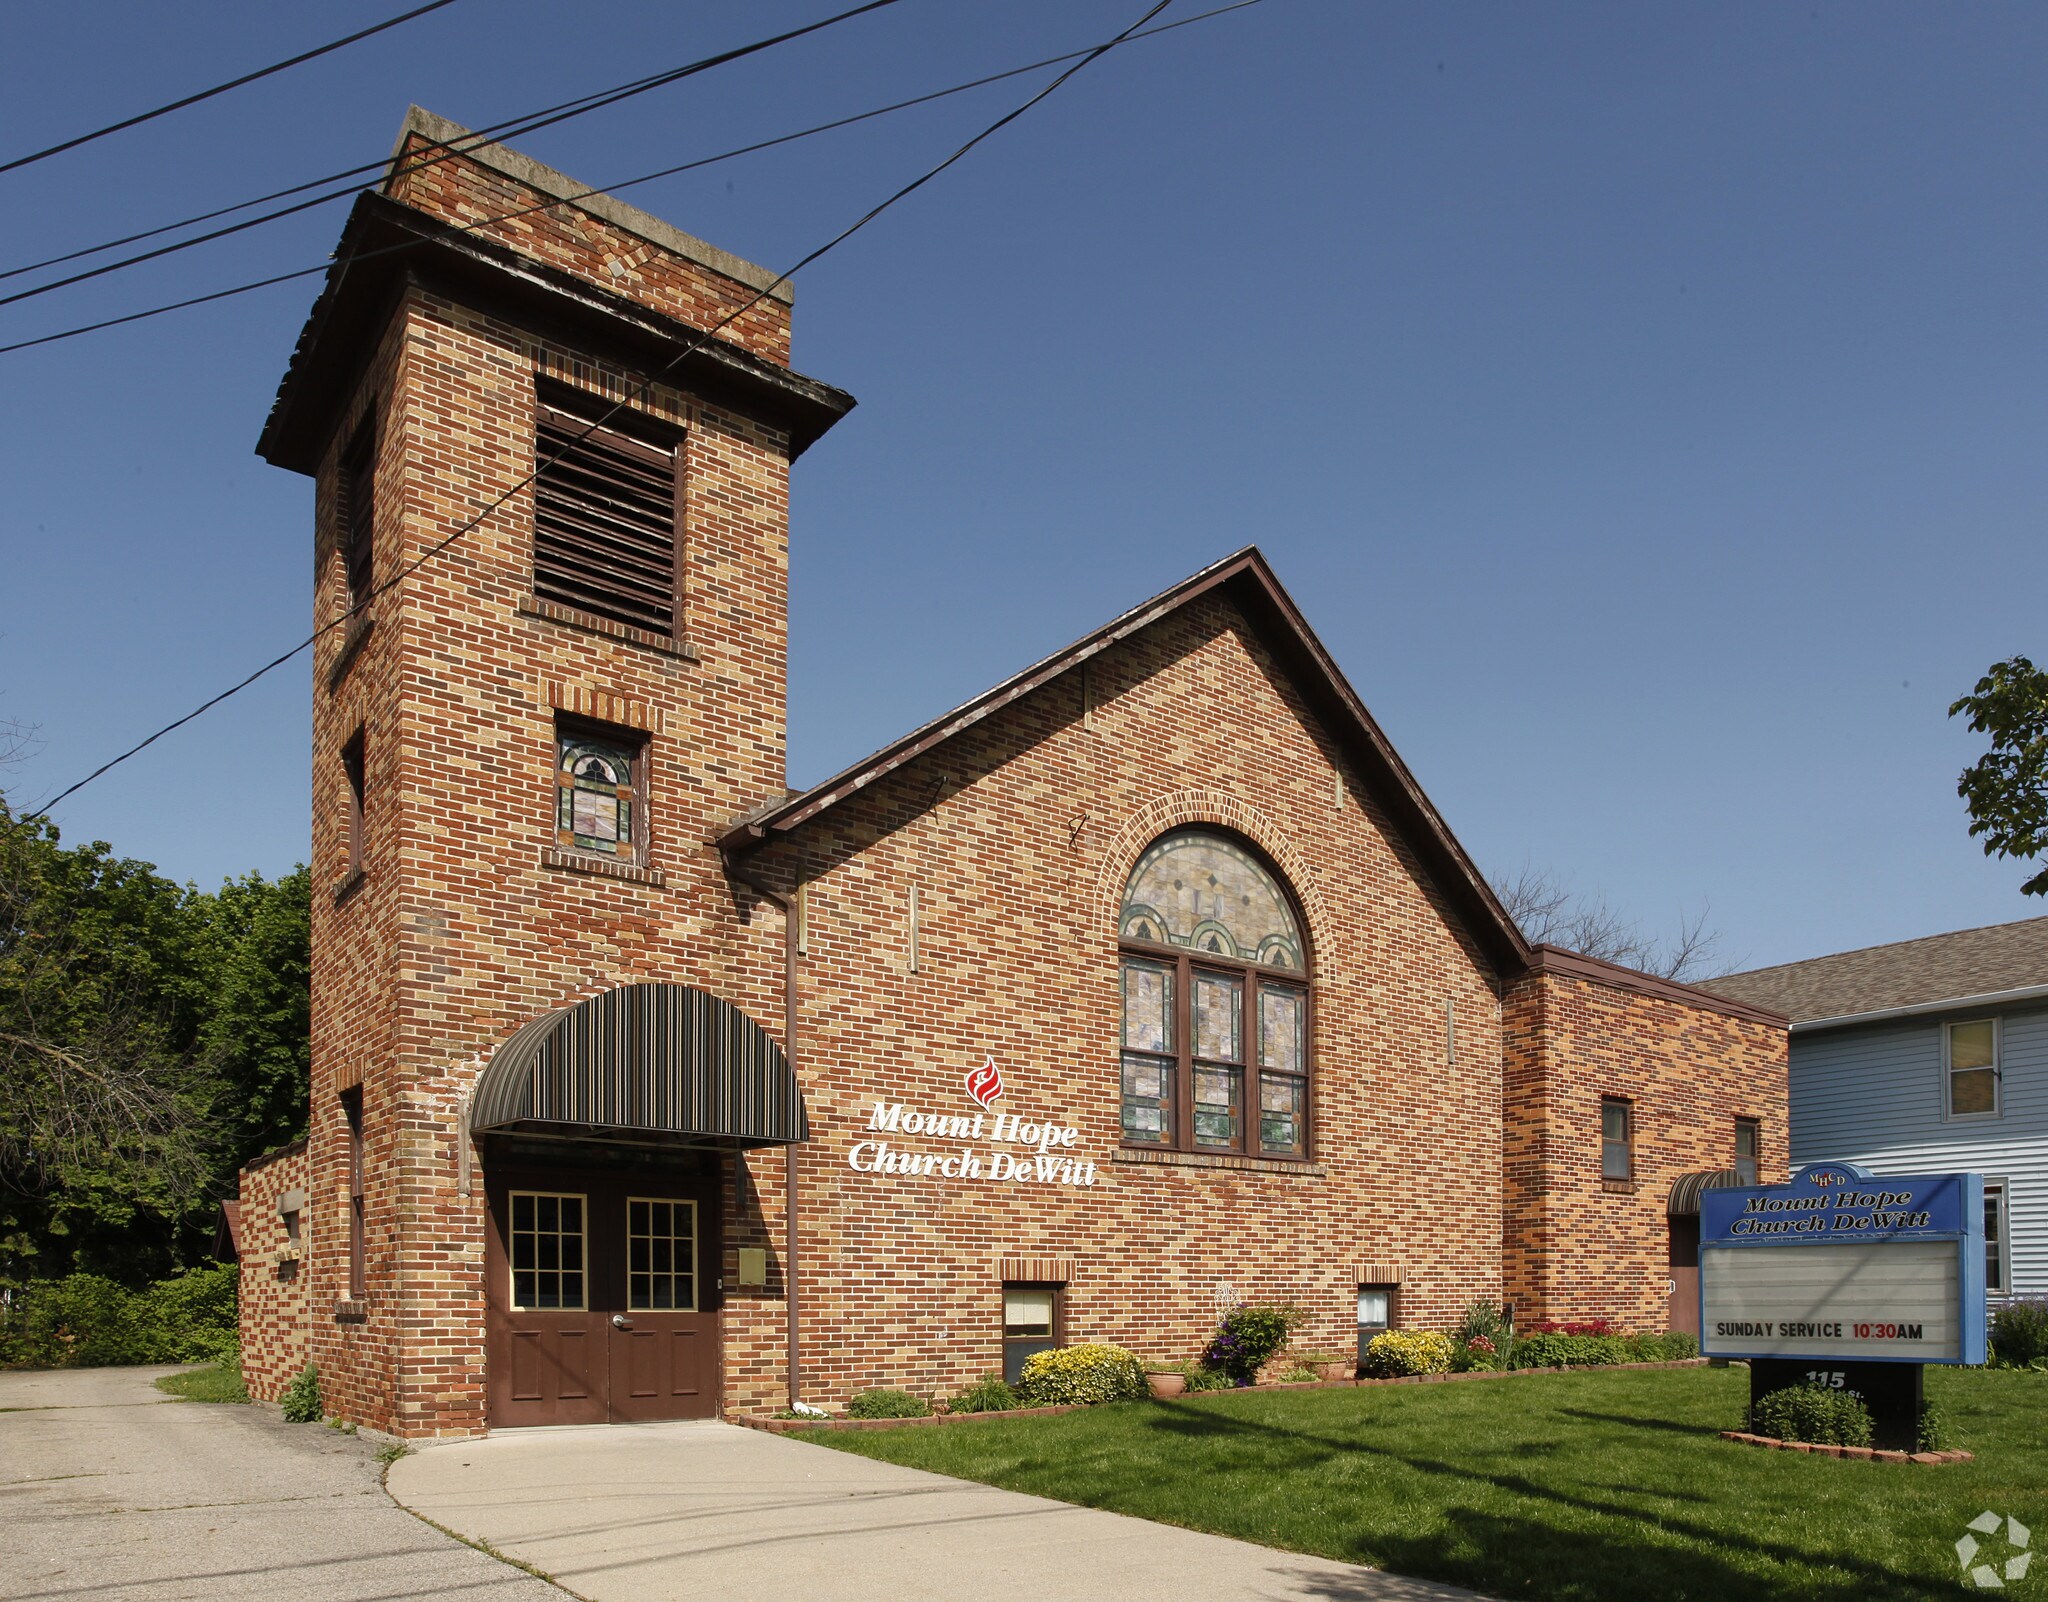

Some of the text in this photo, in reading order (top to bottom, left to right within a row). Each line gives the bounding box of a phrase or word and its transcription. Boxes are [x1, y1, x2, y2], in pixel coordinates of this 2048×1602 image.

[866, 1102, 1079, 1154] Mount Hope
[848, 1142, 1097, 1186] Church DeWitt
[1809, 1172, 1846, 1187] MHCD
[1743, 1191, 1912, 1214] Mount Hope
[1730, 1211, 1931, 1235] Church DeWitt
[1717, 1322, 1923, 1339] SUNDAY SERVICE 10:30AM
[1848, 1390, 1865, 1399] St.
